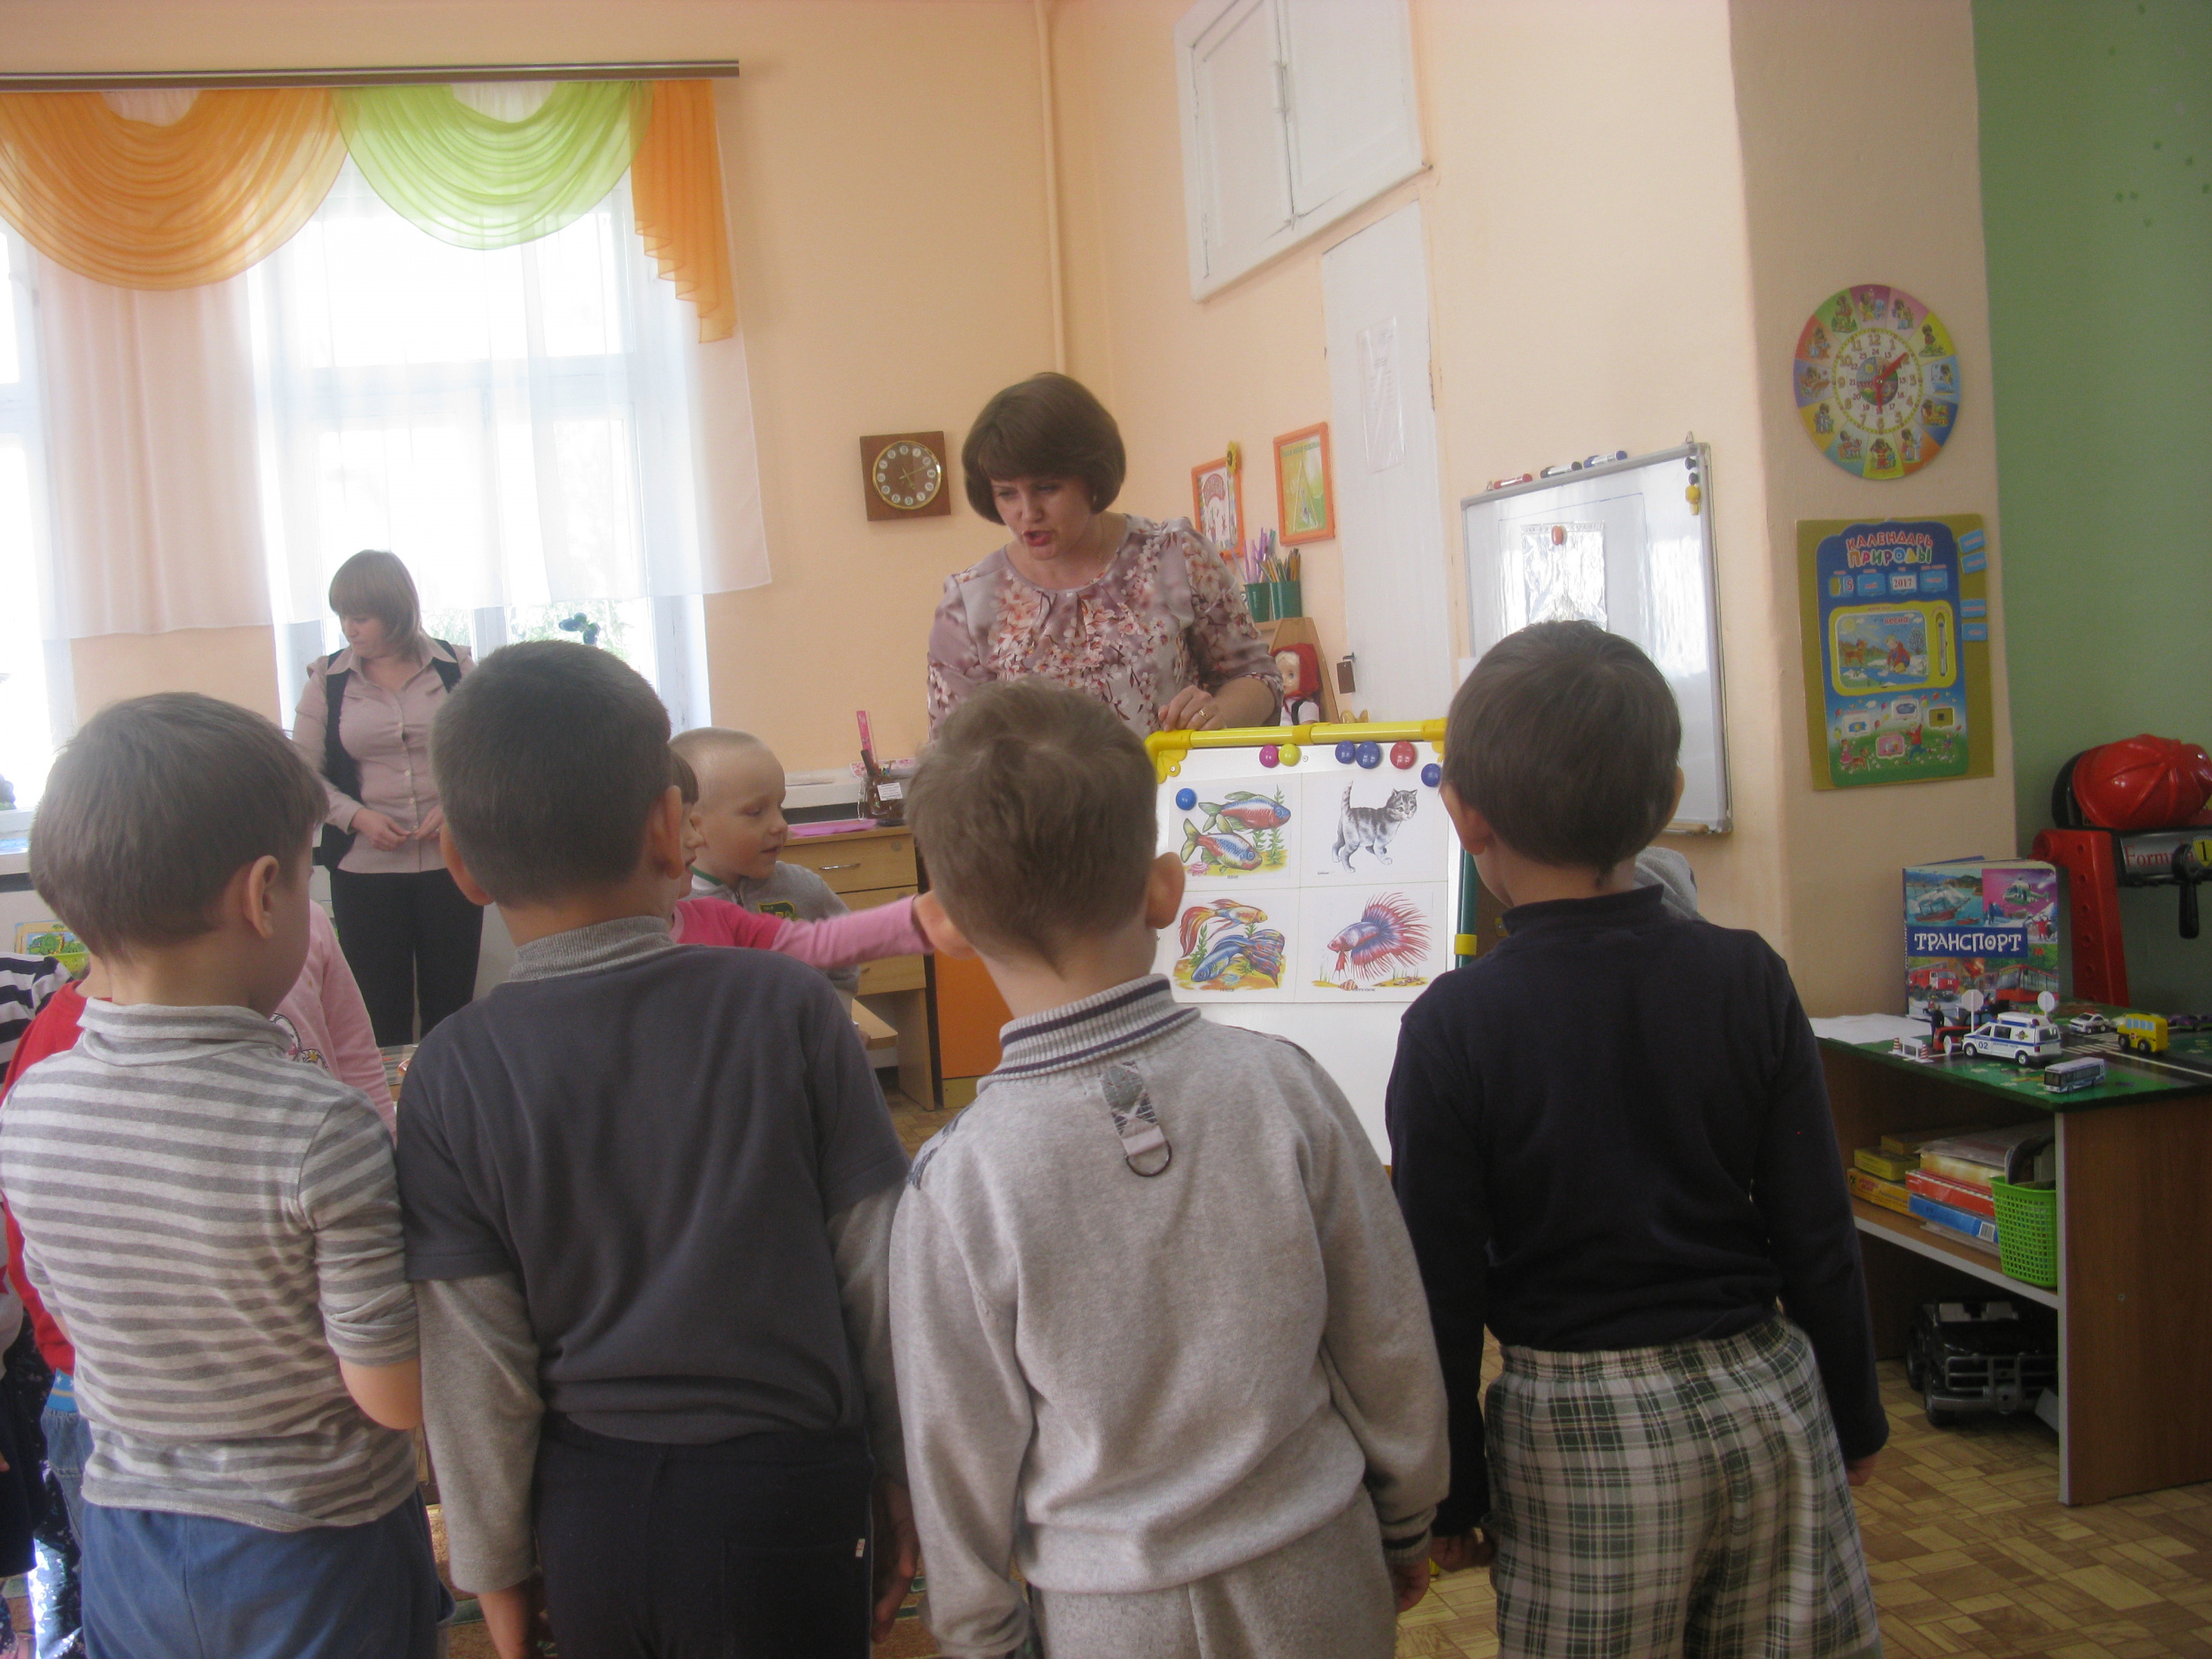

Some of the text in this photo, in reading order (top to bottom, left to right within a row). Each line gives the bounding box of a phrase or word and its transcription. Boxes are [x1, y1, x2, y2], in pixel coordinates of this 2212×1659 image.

[1853, 339, 1863, 351] 11
[1869, 334, 1881, 345] 12
[1890, 338, 1896, 350] 1
[1840, 355, 1853, 366] 10
[1860, 413, 1866, 426] 7
[1846, 530, 1933, 551] КАЛЕНДАРЬ
[1847, 547, 1932, 568] ПРИРОДЫ
[1847, 580, 1854, 591] 5
[1893, 578, 1913, 588] 2017
[2124, 838, 2194, 867] Forma
[2200, 841, 2208, 862] 1
[1914, 933, 2022, 952] ТРАНСПОРТ
[1978, 1041, 1988, 1050] 02
